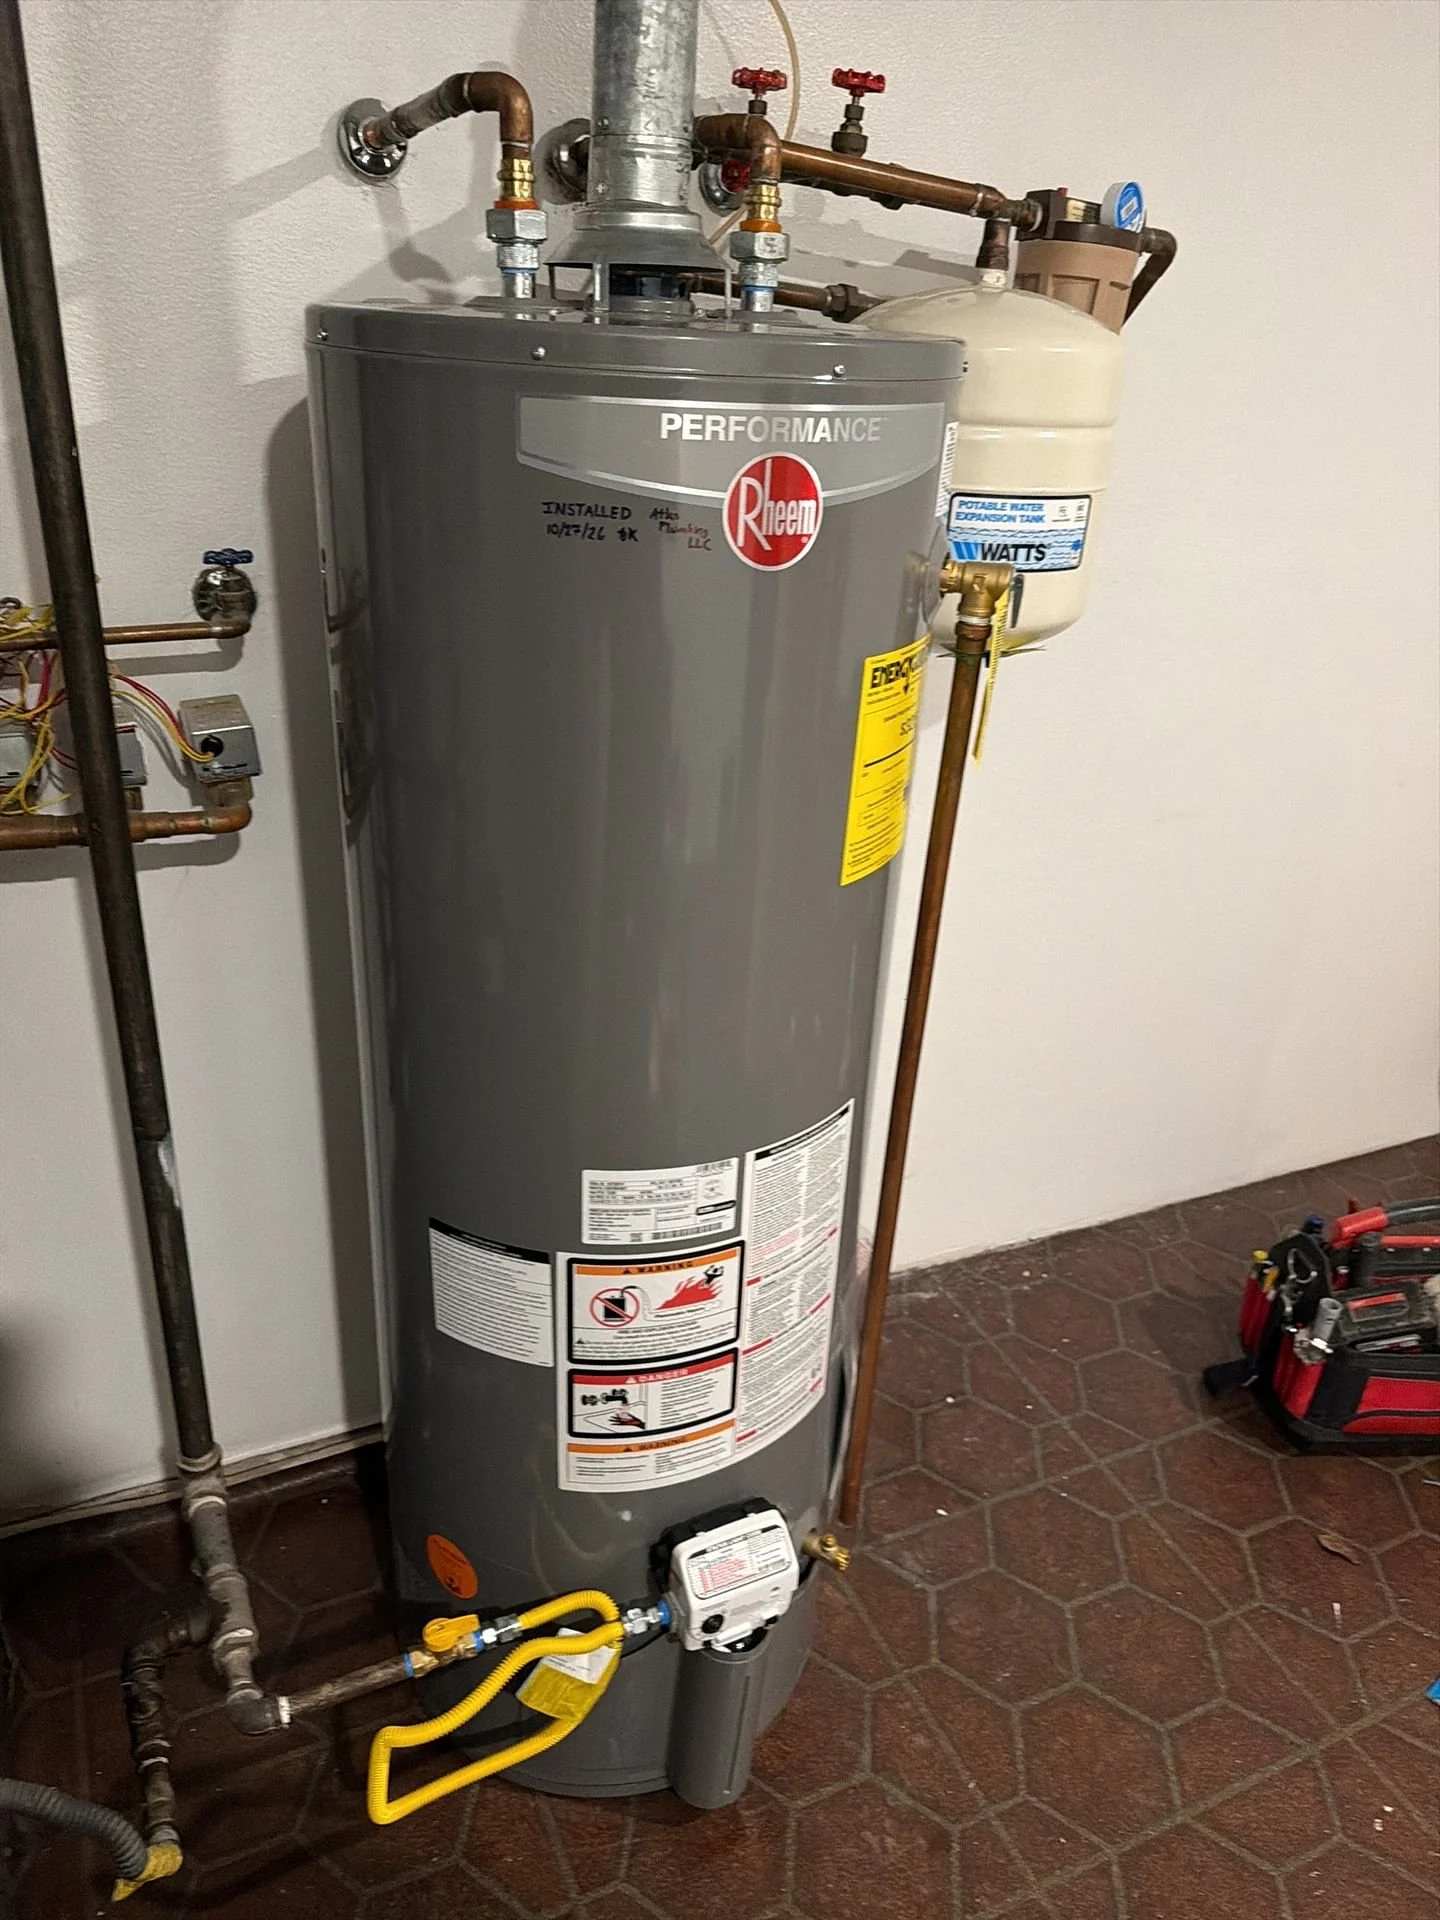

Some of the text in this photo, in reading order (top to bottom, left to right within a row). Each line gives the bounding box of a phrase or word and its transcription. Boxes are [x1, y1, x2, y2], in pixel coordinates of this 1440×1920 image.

[661, 413, 881, 442] PERFORMANCE
[542, 501, 632, 520] INSTALLED
[736, 459, 817, 551] Rheem
[959, 500, 1044, 512] POTABLE WATER
[956, 511, 1045, 523] EXPANSION TANK
[687, 537, 712, 551] LLC
[981, 542, 1048, 562] WATTS
[638, 1260, 694, 1274] WARNING
[638, 1368, 689, 1382] DANGER
